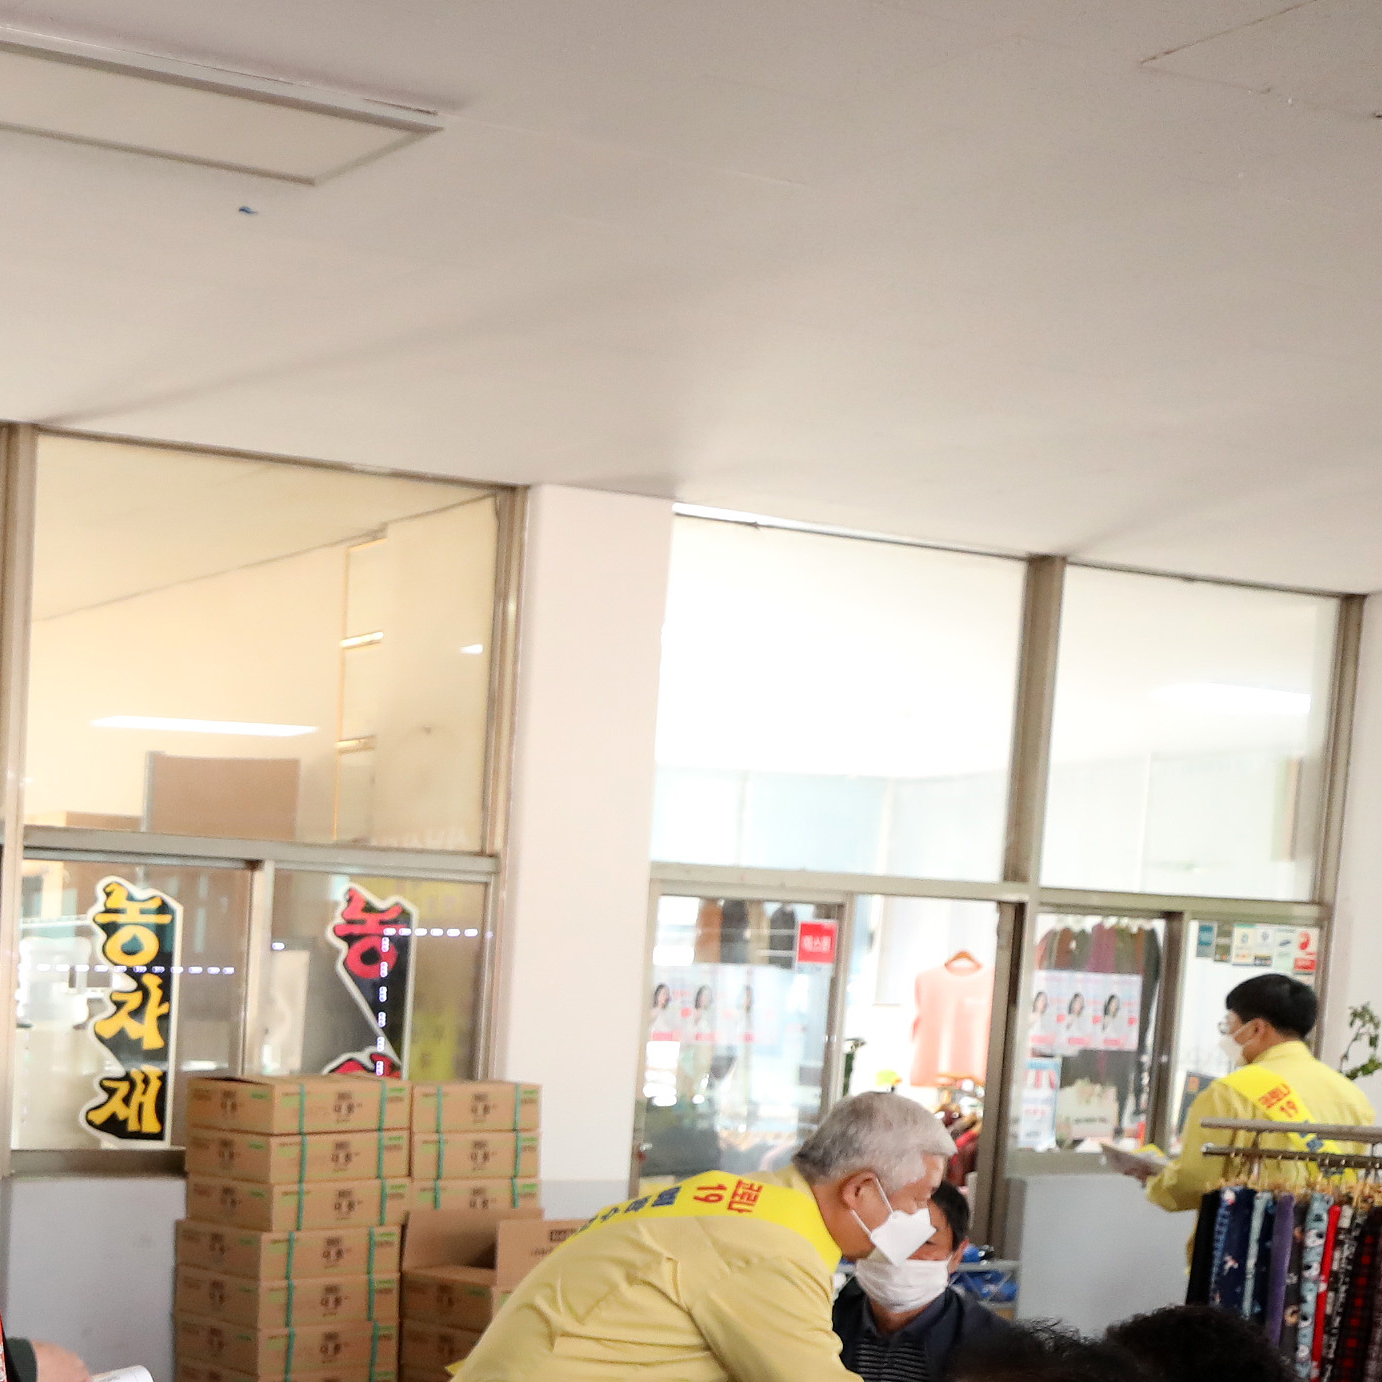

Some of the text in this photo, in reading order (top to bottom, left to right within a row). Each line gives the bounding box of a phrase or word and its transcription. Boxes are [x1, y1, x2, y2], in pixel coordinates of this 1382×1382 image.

[86, 881, 174, 1134] 농자재
[1258, 1083, 1291, 1109] 코로나
[1280, 1101, 1299, 1118] 19
[693, 1184, 727, 1204] 19
[727, 1179, 764, 1214] 코로나
